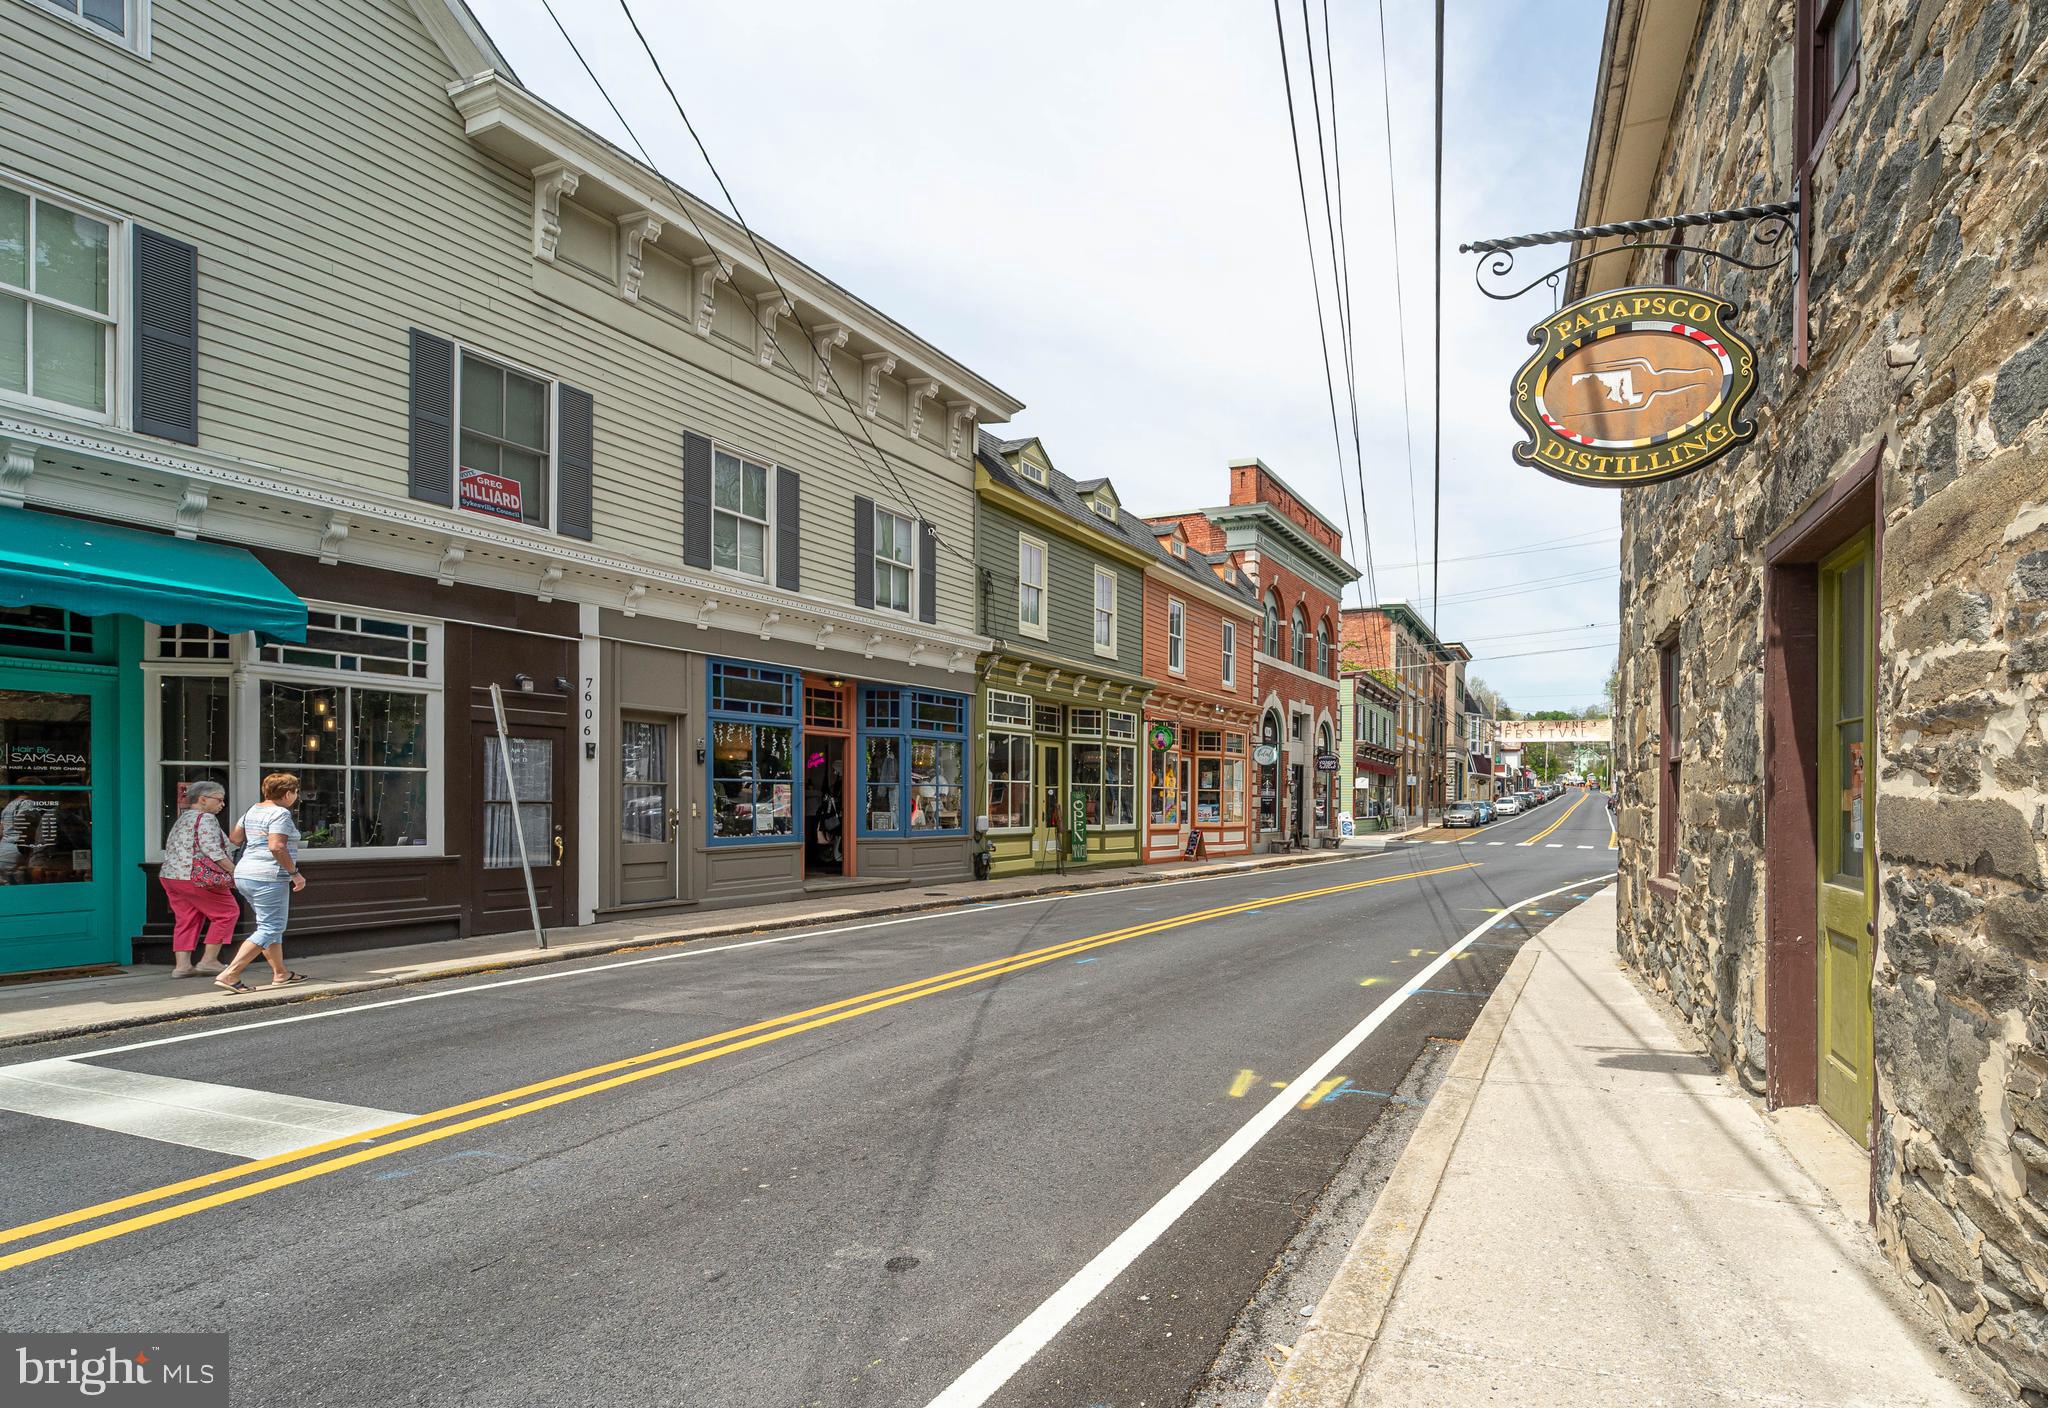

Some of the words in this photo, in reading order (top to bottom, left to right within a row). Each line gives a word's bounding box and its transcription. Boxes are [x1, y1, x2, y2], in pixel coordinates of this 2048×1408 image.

[1554, 297, 1711, 341] PATAPSCO
[1541, 423, 1728, 474] DISTILLING
[476, 476, 503, 489] GREG
[460, 481, 520, 509] HILLIARD
[461, 498, 495, 512] Sykesville
[496, 507, 520, 518] Council
[584, 678, 593, 736] 7606
[1505, 721, 1529, 729] ART
[1538, 721, 1545, 729] &
[1555, 721, 1587, 729] WINE
[1505, 729, 1587, 739] FESTIVAL
[11, 753, 87, 764] SAMSARA
[12, 745, 34, 753] Hair
[36, 746, 50, 754] By
[1073, 799, 1084, 842] OPEN
